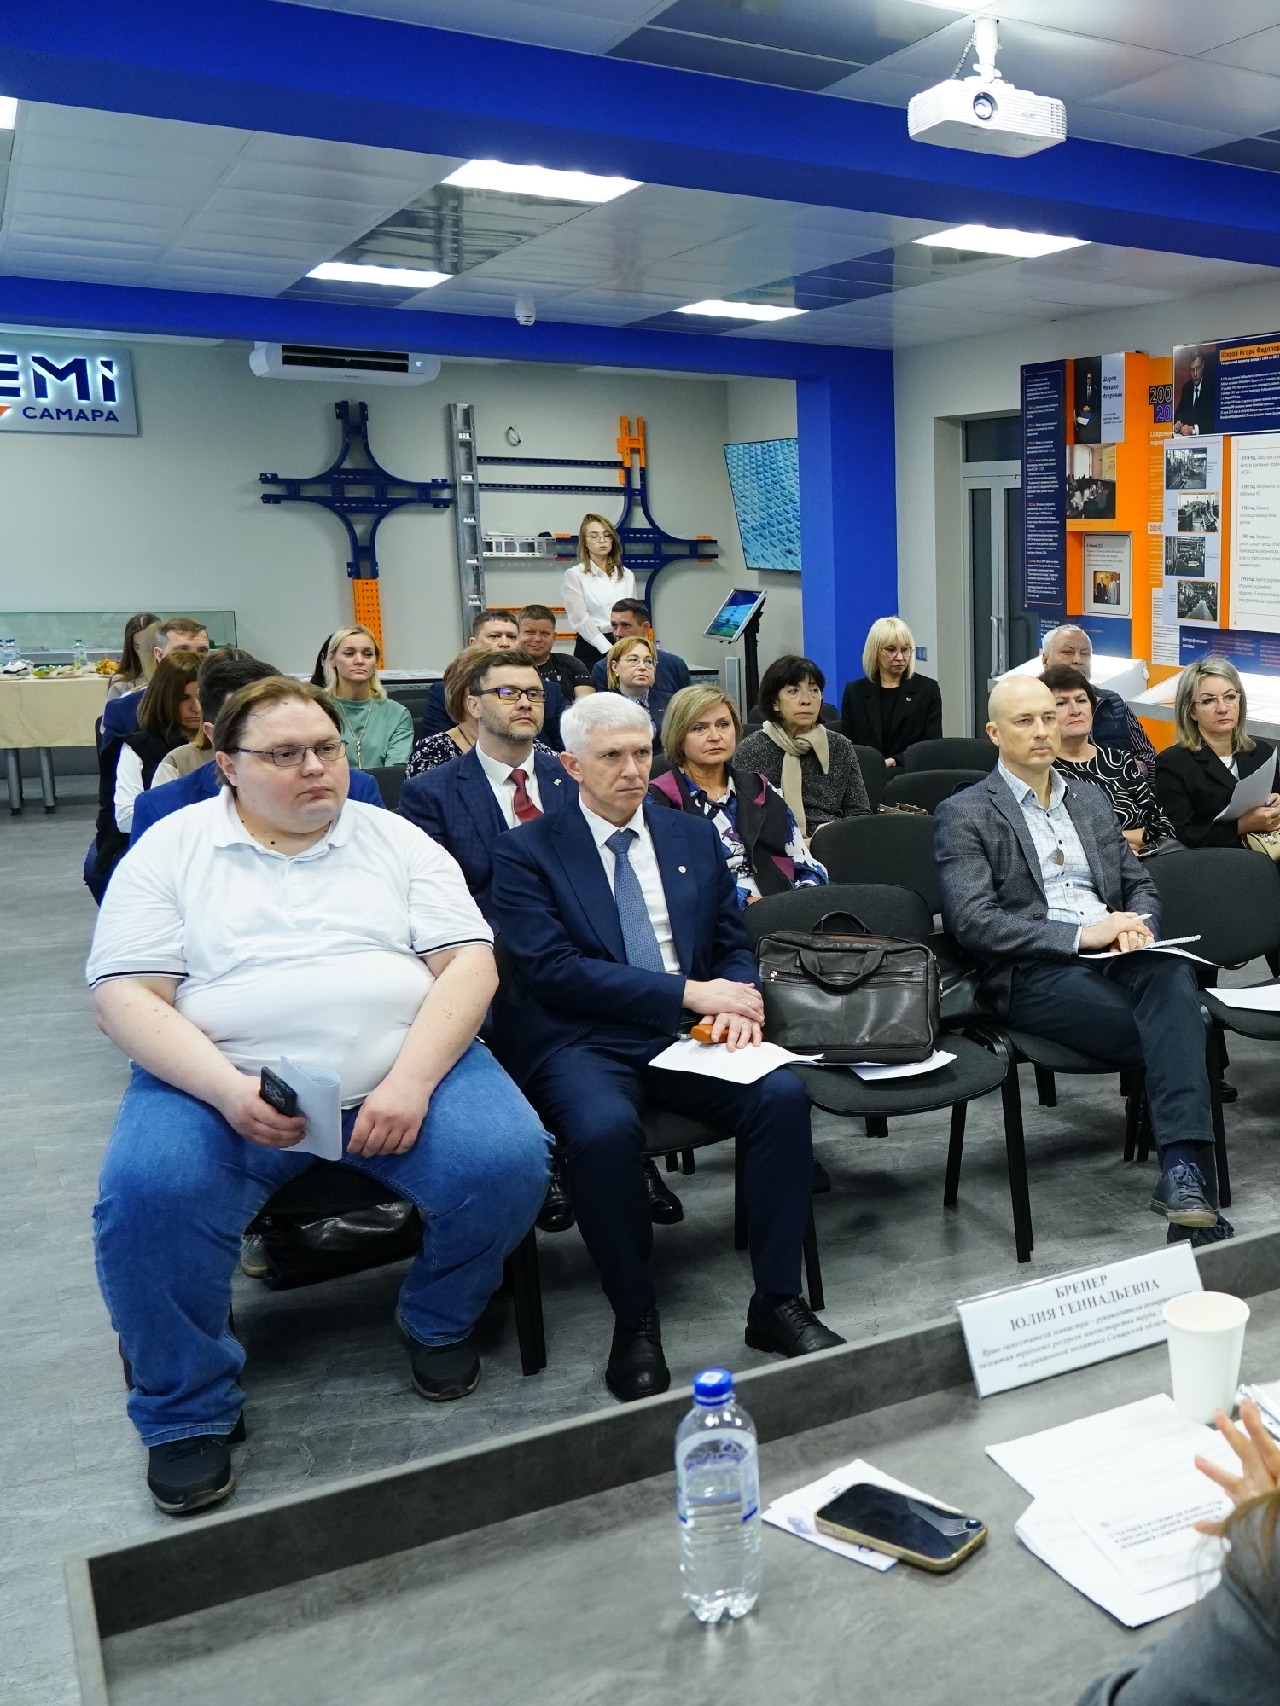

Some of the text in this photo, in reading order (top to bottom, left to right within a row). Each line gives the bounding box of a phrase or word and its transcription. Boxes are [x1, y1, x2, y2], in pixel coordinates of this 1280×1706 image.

[1150, 386, 1173, 403] 200
[22, 406, 119, 422] САМАРА
[1055, 1274, 1108, 1298] БРЕНЕР
[1010, 1279, 1160, 1331] ЮЛИЯ ГЕННАДЬЕВНА
